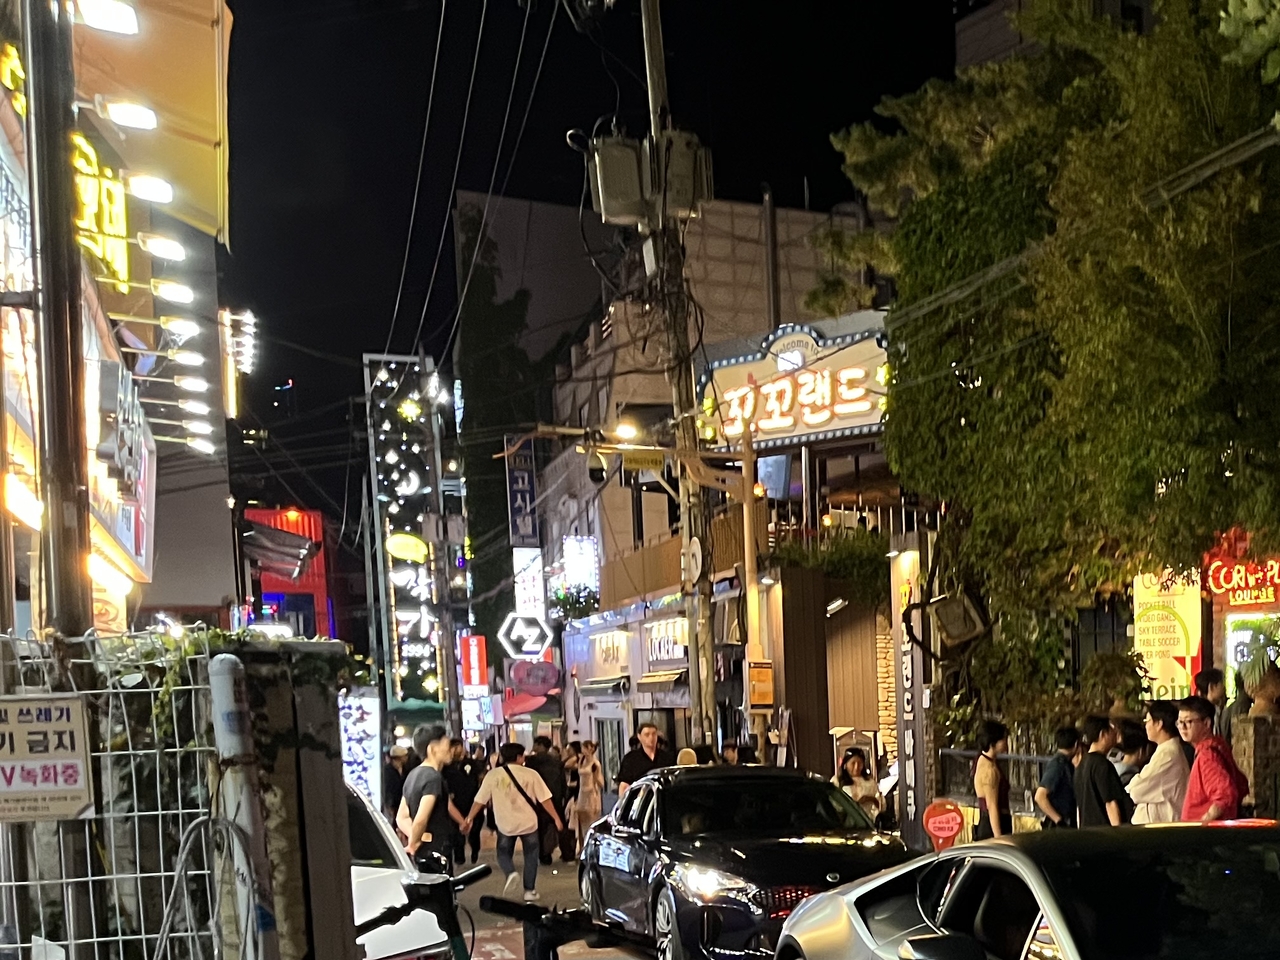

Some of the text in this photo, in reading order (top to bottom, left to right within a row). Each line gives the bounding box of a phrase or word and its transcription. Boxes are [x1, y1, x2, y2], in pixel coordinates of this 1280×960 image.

[1138, 600, 1176, 611] POCKET BALL
[1156, 613, 1177, 622] GAMES
[510, 618, 542, 652] AZ
[1138, 625, 1176, 635] SKY TERRACE
[1139, 637, 1180, 647] TABLE SOCCER
[402, 645, 430, 657] 1994
[1155, 650, 1170, 659] PONG
[17, 705, 71, 723] 쓰레기
[27, 730, 76, 754] 금지
